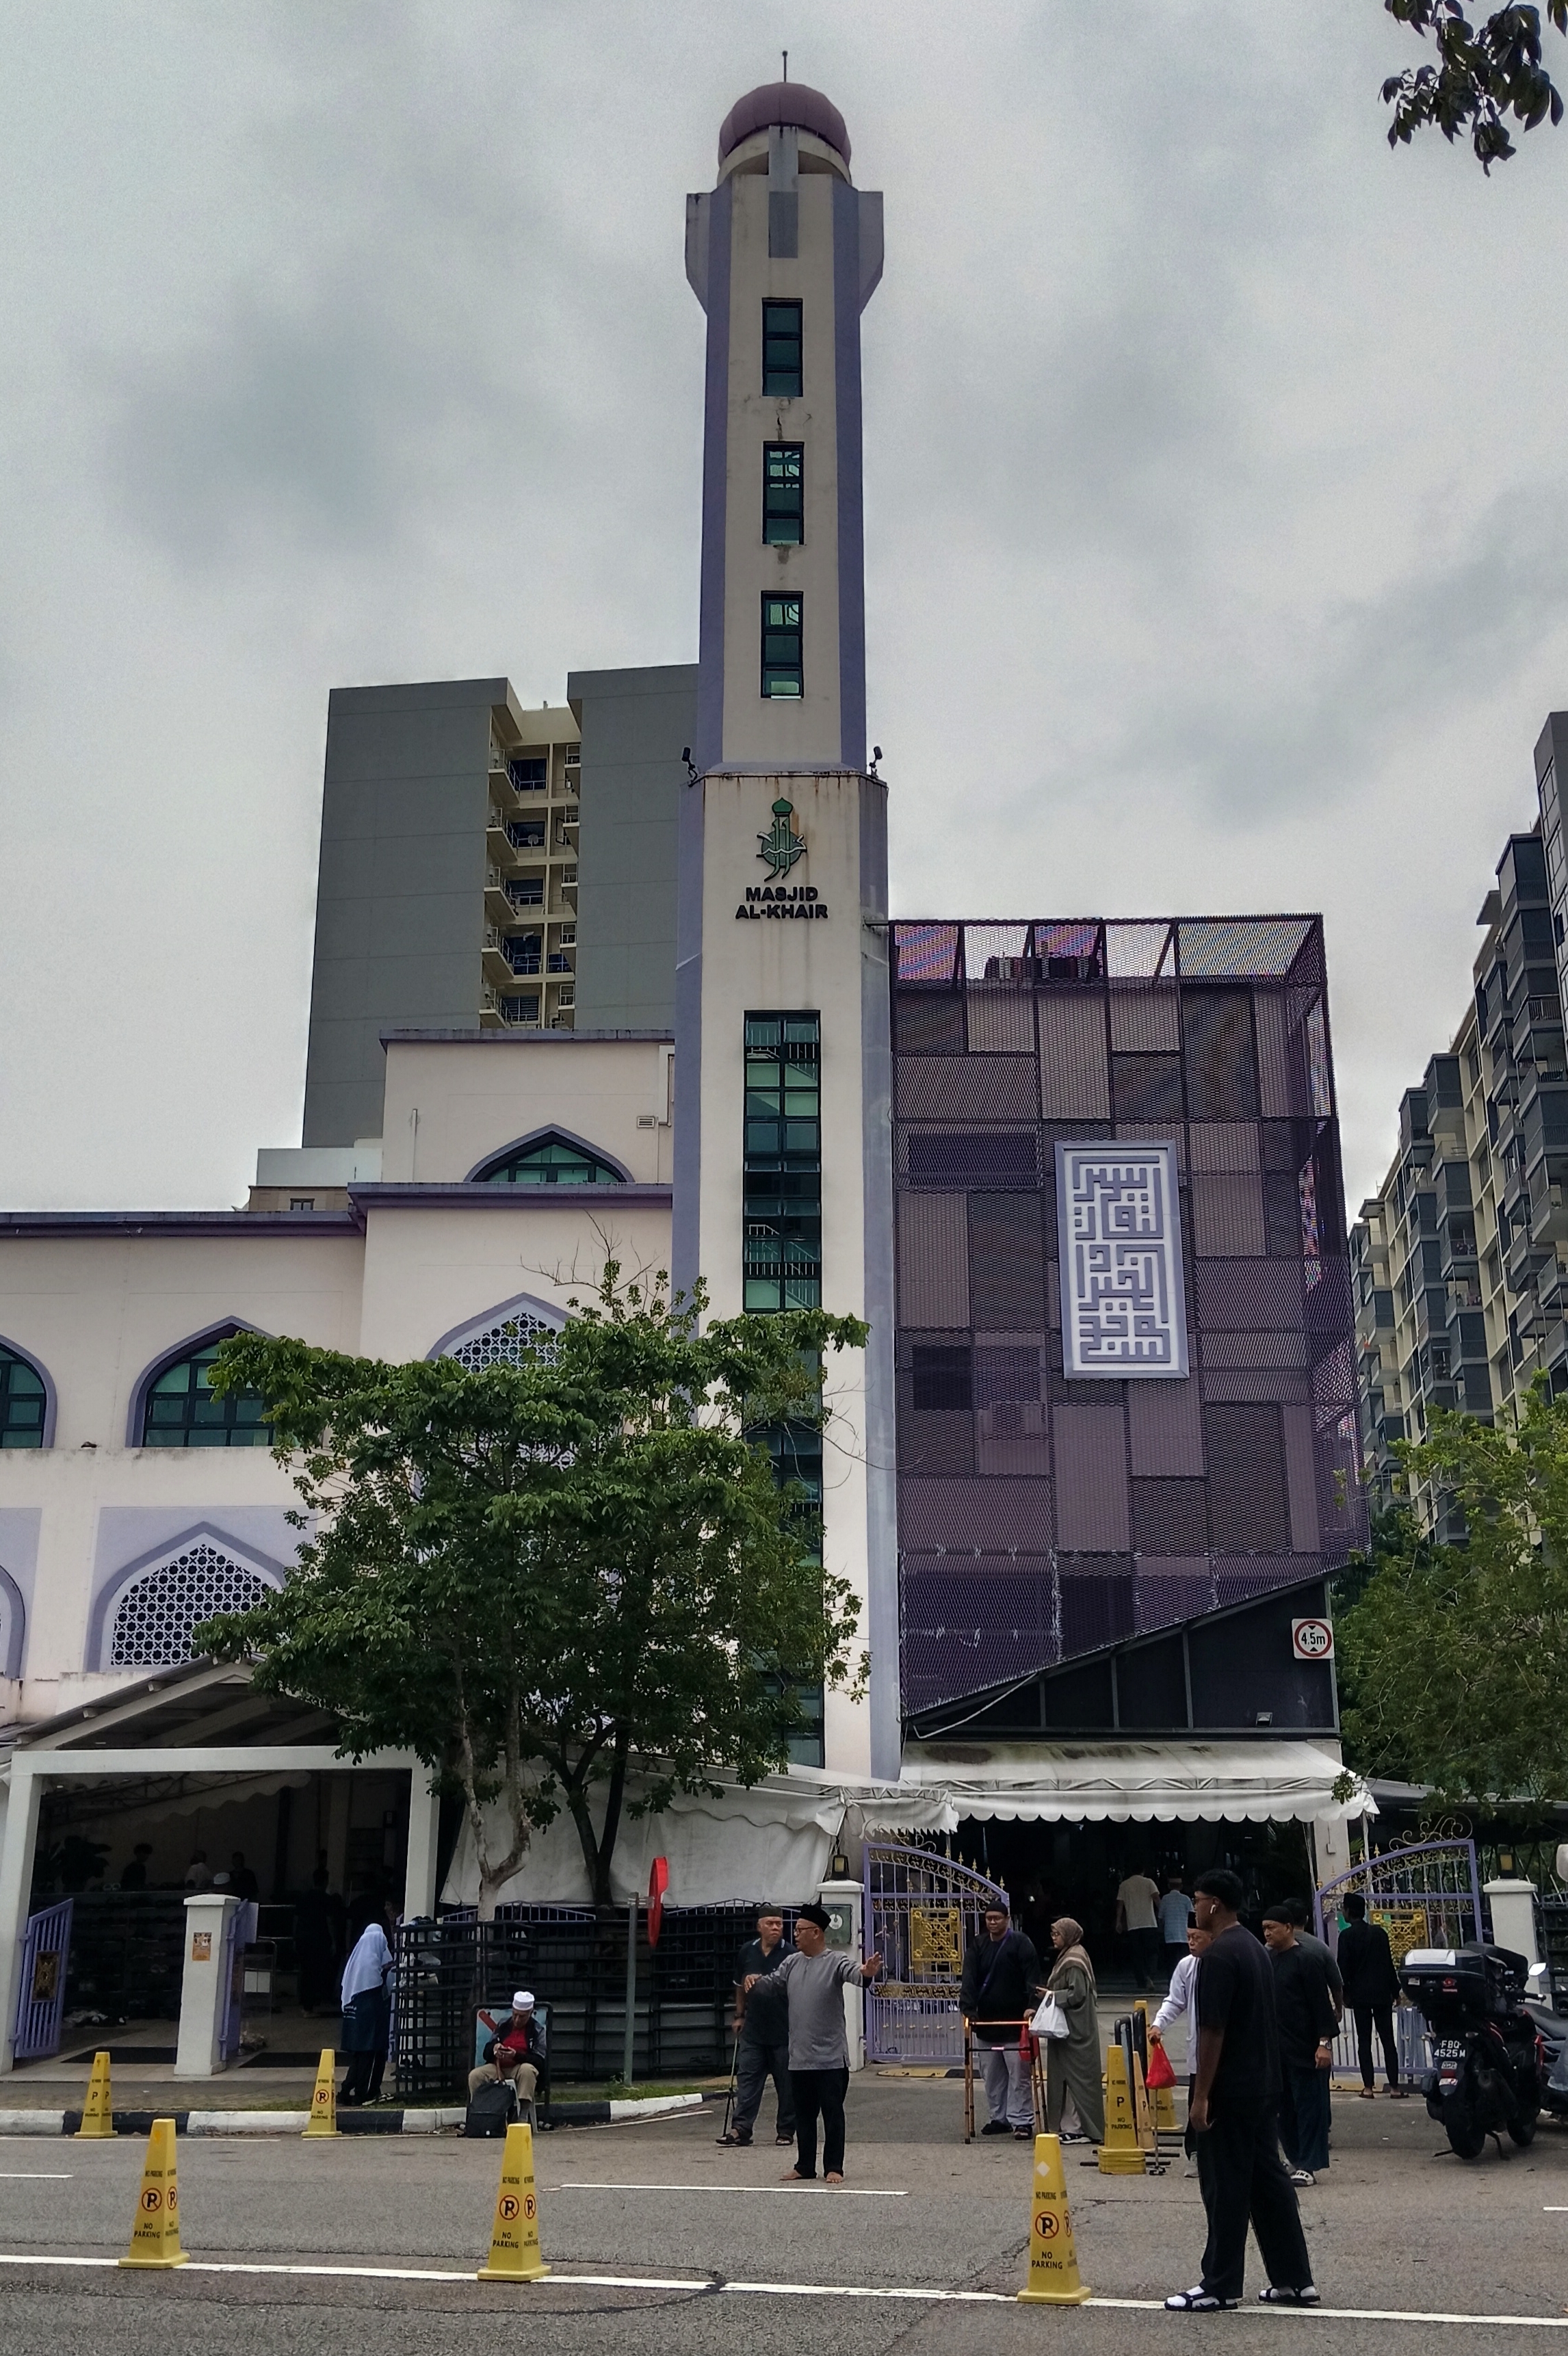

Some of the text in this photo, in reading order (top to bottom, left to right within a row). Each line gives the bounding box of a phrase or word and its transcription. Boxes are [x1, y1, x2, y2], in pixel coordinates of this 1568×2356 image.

[746, 887, 818, 902] MASJID
[735, 904, 828, 919] AL-KHAIR
[1301, 1632, 1326, 1645] 4.5m
[144, 2222, 153, 2230] NO
[134, 2230, 160, 2239] PARKING
[493, 2239, 519, 2249] PARKING
[1041, 2251, 1053, 2260] NO
[1032, 2260, 1063, 2270] PARKING
